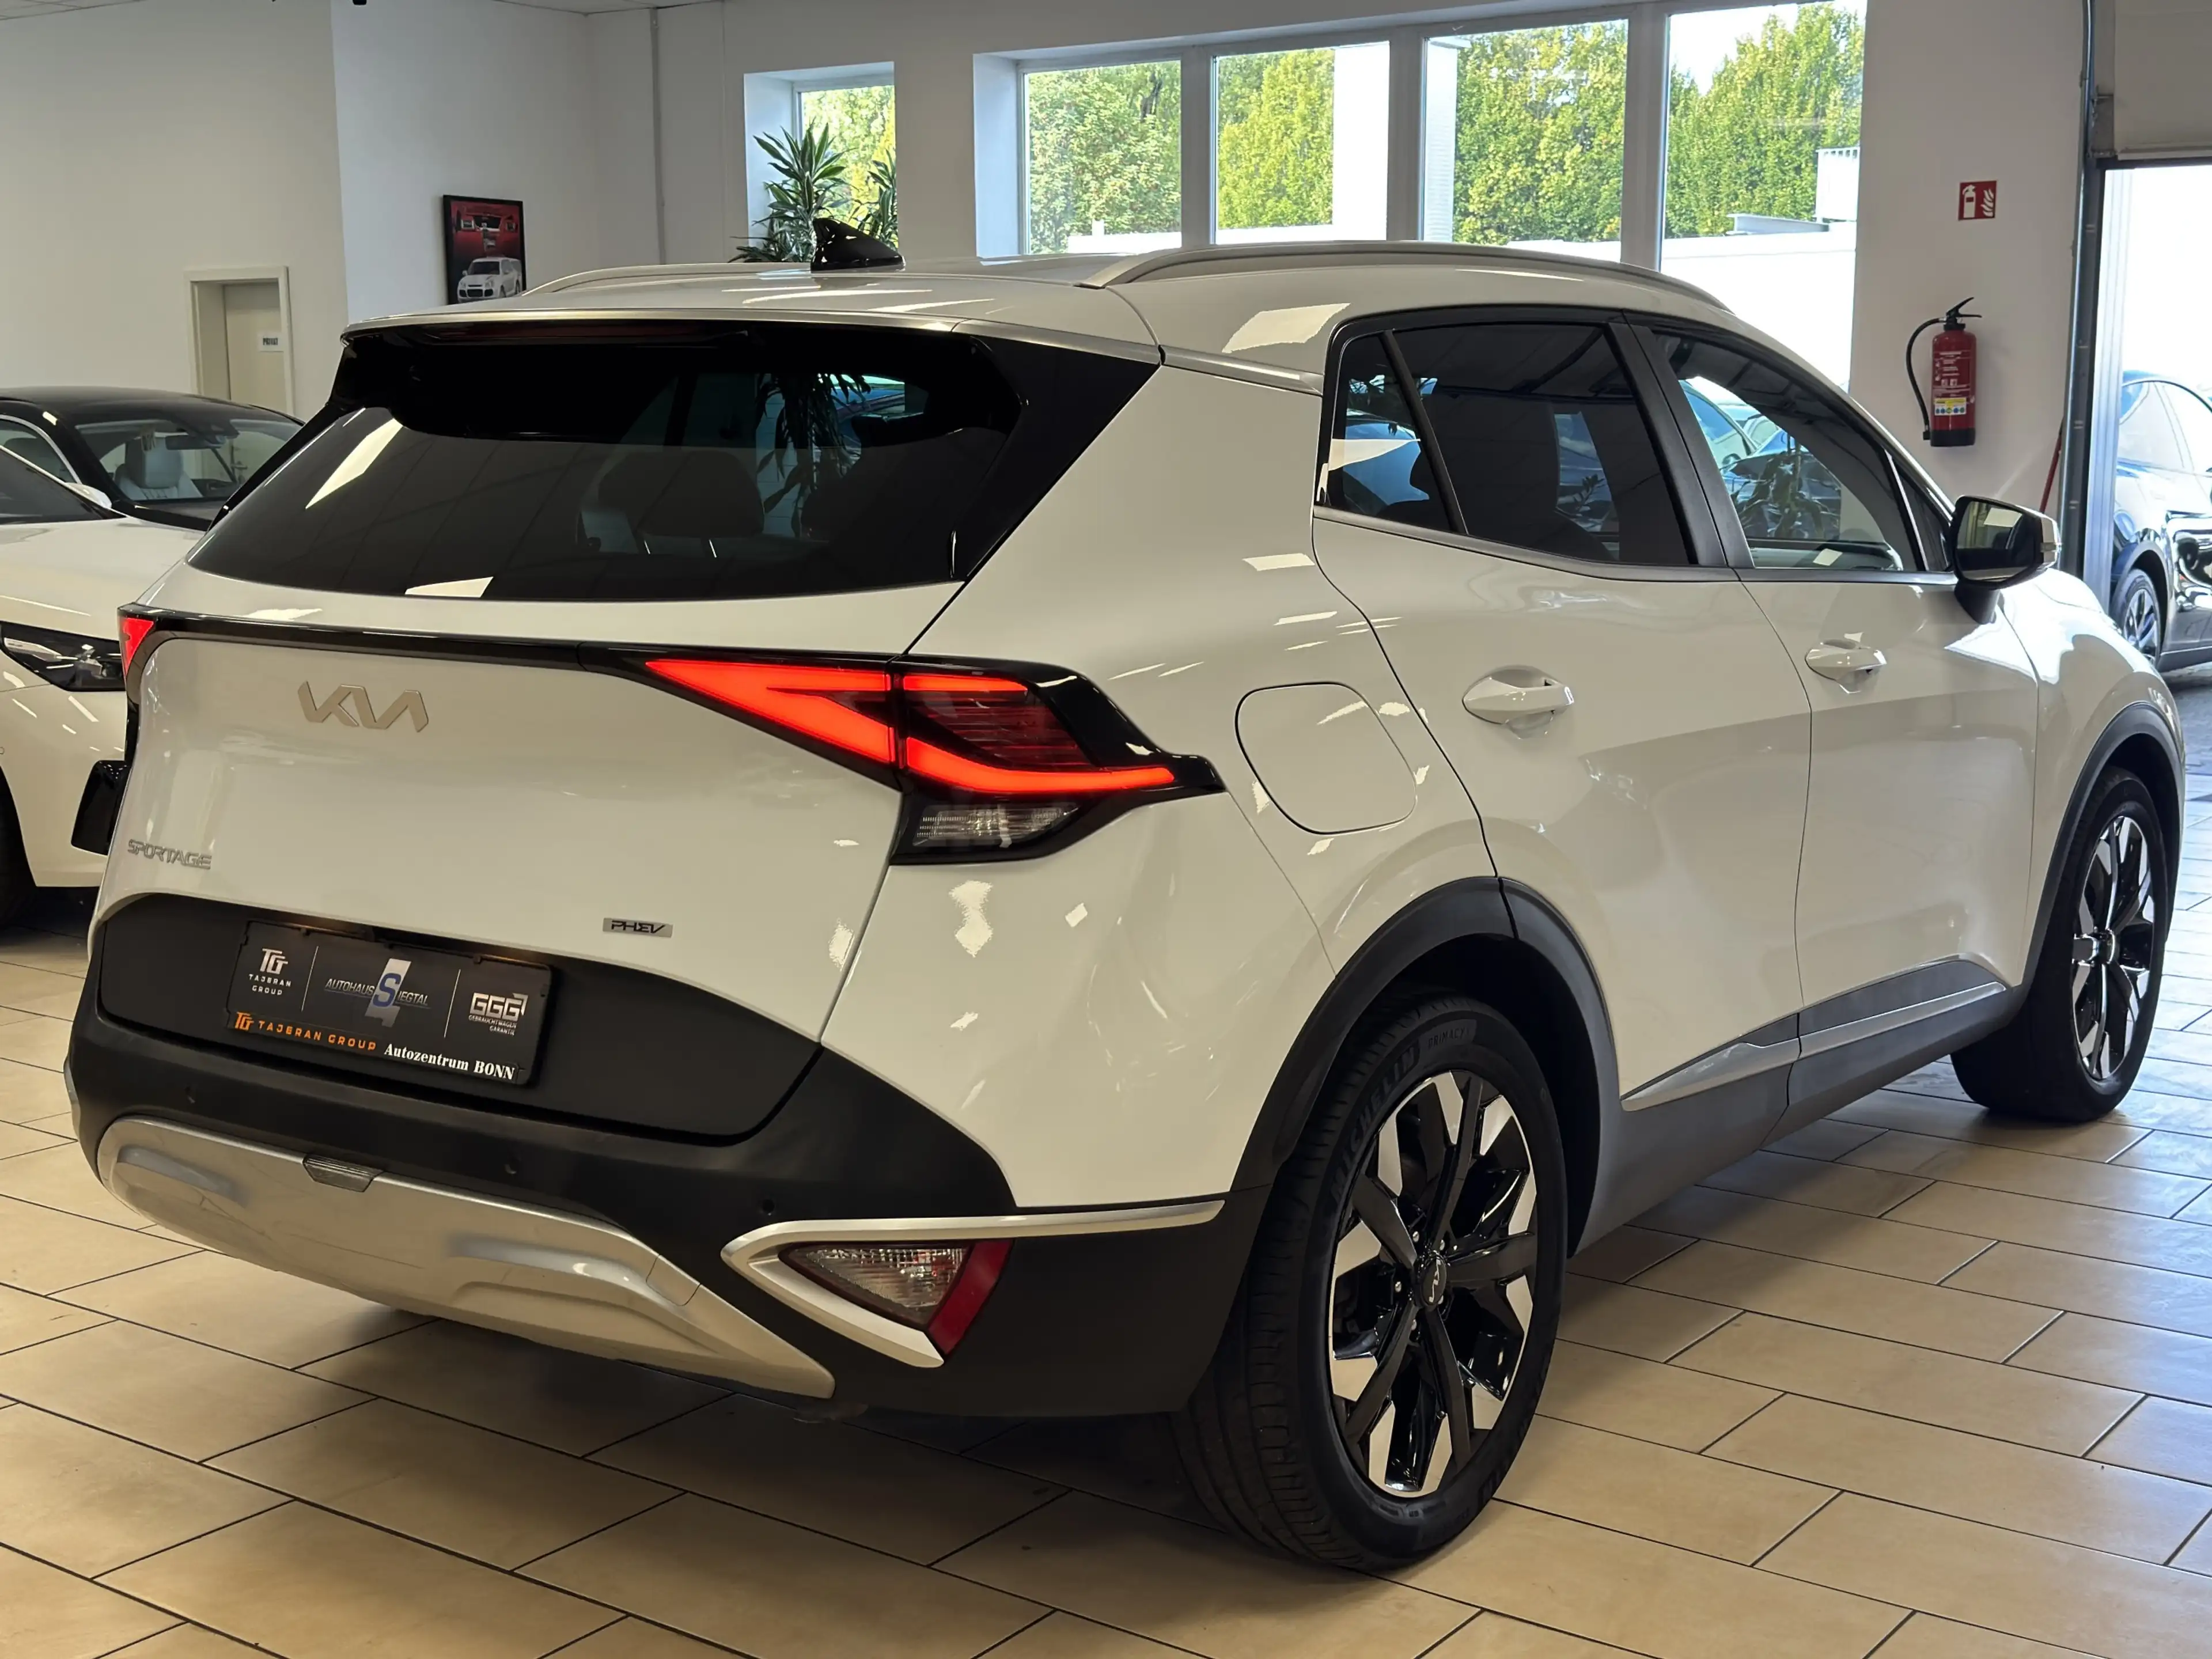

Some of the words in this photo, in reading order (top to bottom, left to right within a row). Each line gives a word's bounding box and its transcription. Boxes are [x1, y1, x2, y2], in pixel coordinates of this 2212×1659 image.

[297, 681, 429, 733] KIA
[127, 839, 212, 870] SPORTAGE
[611, 921, 665, 933] PHEV
[249, 974, 291, 987] TAJERAN
[252, 985, 282, 995] GROUP
[325, 979, 375, 996] AUTOHAUS
[469, 993, 522, 1021] GGG
[468, 1014, 517, 1029] GEBRAUCHTWAGEN
[259, 1020, 321, 1040] TAJERAN
[328, 1035, 376, 1051] GROUP
[384, 1044, 469, 1071] Autozentrum
[474, 1060, 515, 1080] BONN
